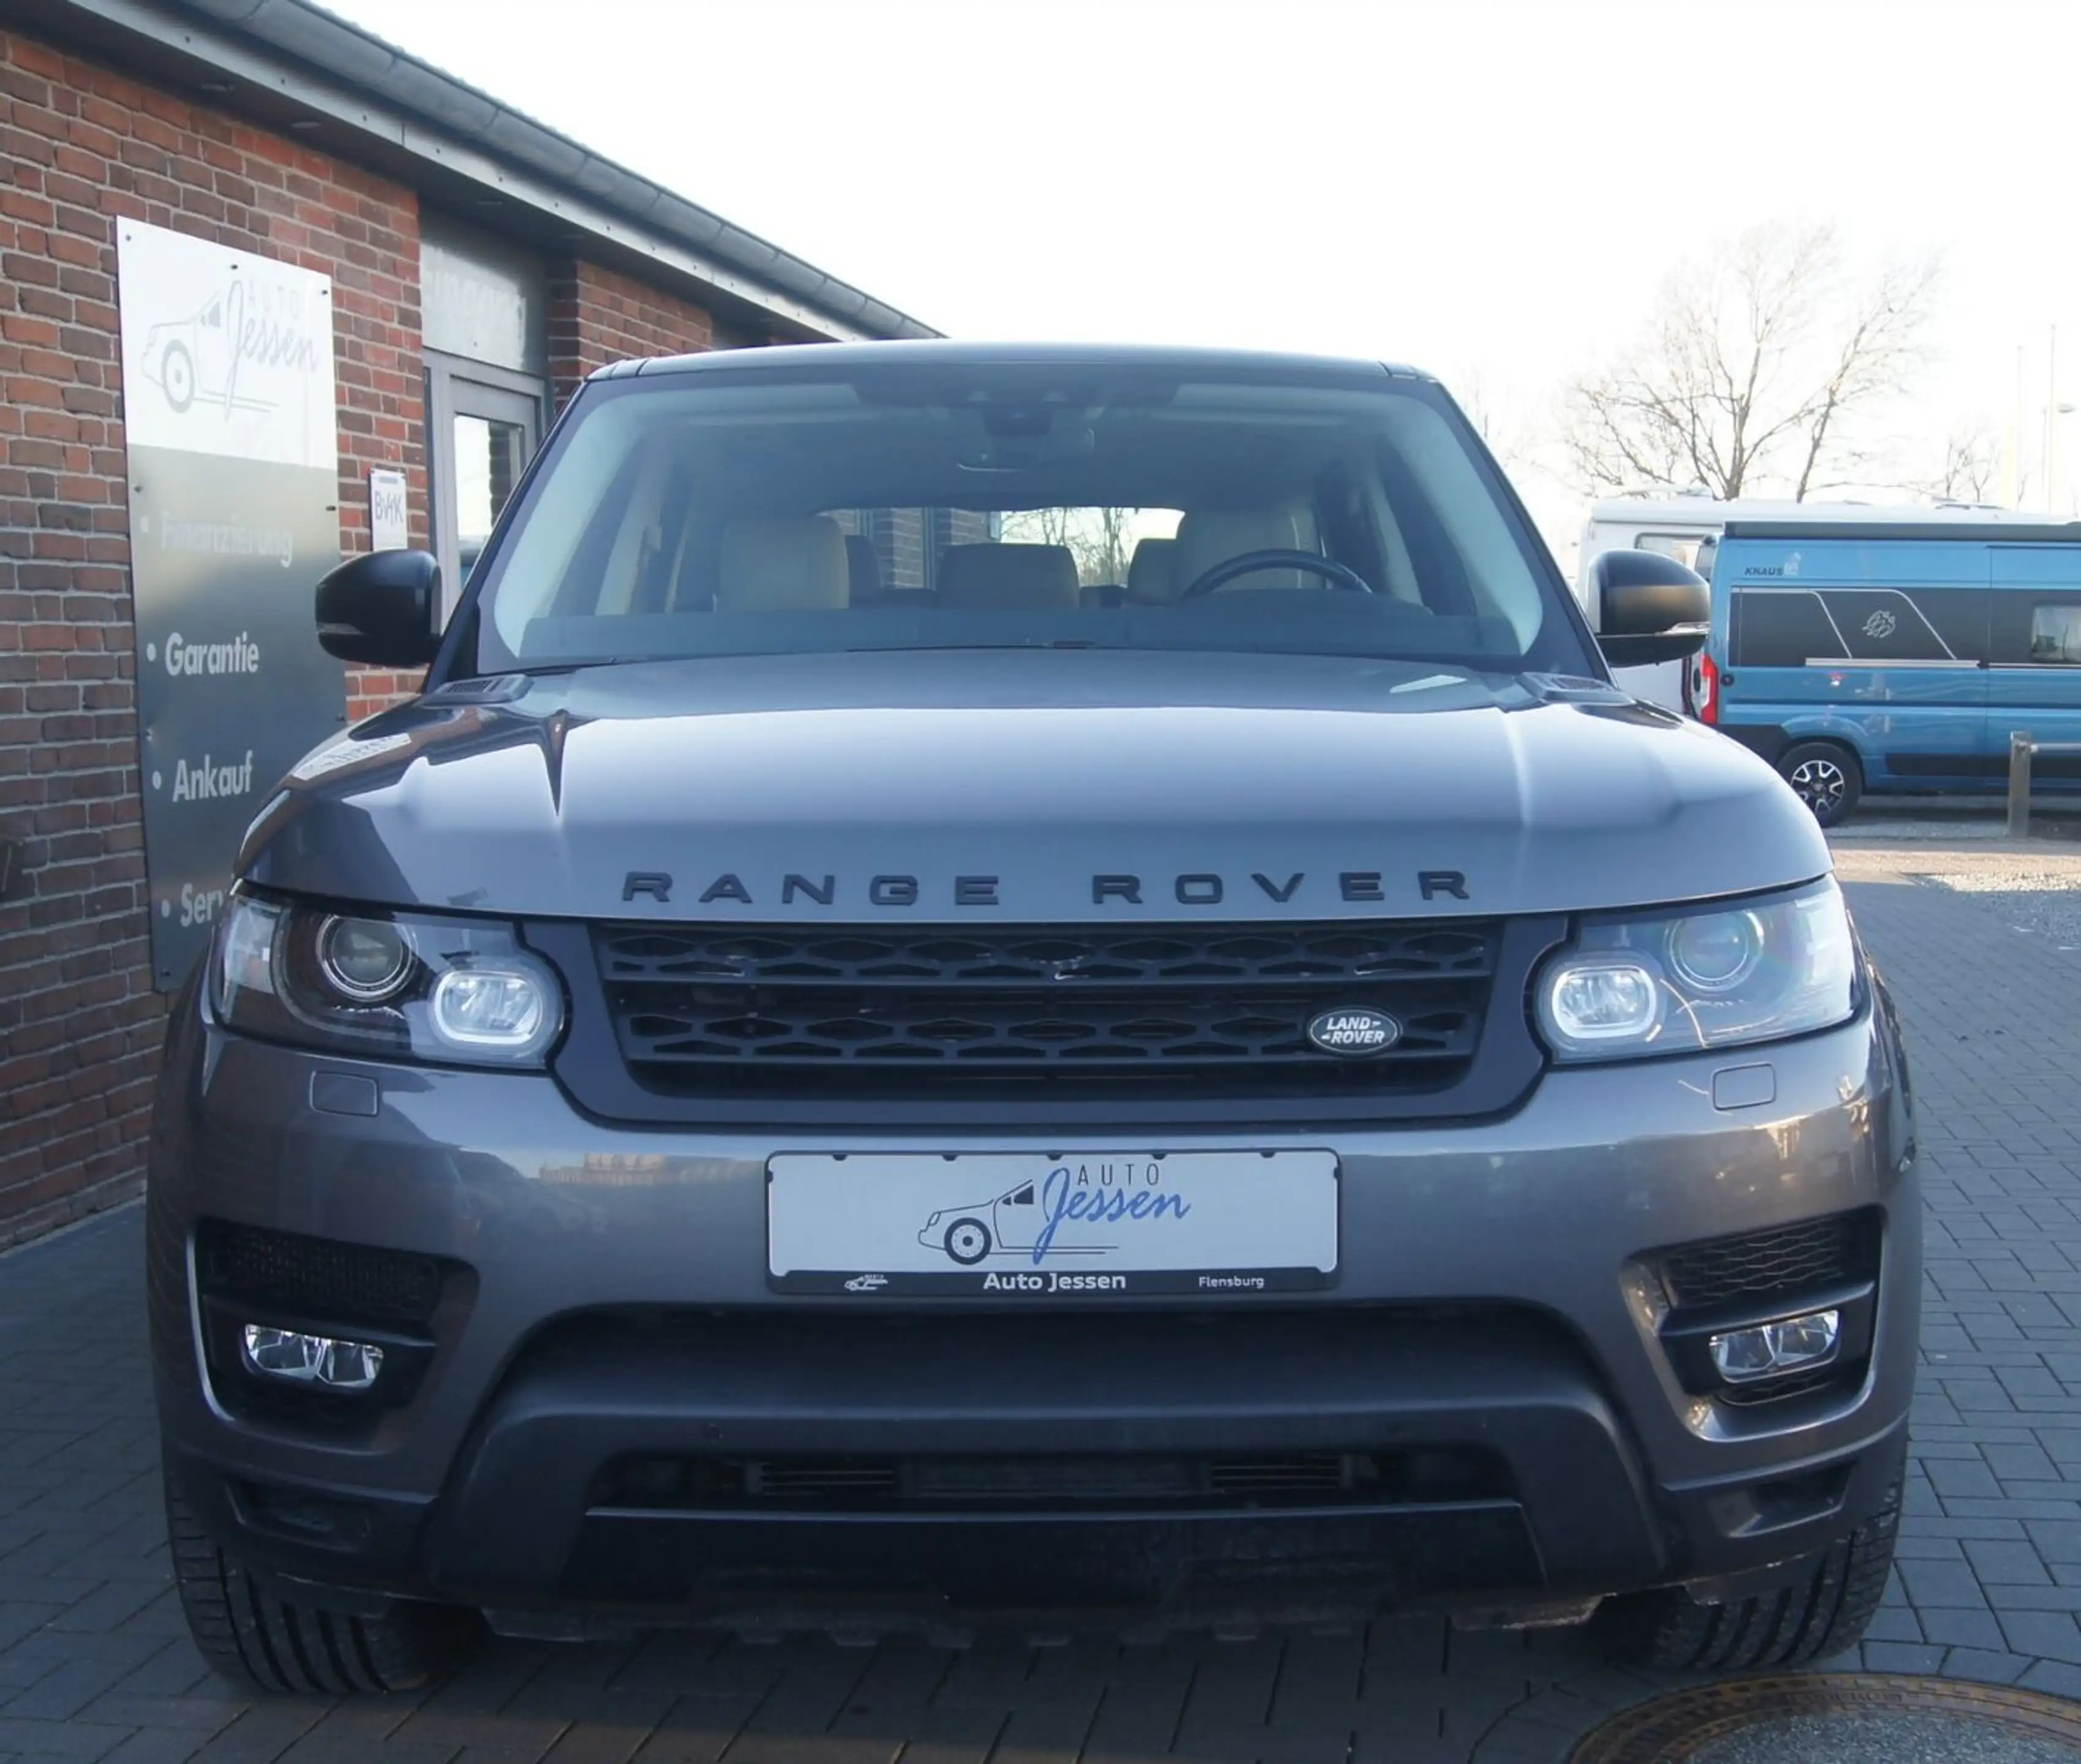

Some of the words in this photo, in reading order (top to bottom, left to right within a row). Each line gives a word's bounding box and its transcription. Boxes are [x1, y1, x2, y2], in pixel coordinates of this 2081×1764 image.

[247, 278, 300, 319] AUTO
[225, 279, 320, 422] Jessen
[165, 631, 260, 676] Garantie
[172, 749, 254, 802] Ankauf
[621, 871, 999, 906] RANGE
[1092, 870, 1470, 904] ROVER
[1077, 1163, 1159, 1186] AUTO
[1033, 1167, 1191, 1265] Jessen
[983, 1273, 1043, 1290] Auto
[1047, 1272, 1126, 1292] Jessen
[1199, 1275, 1265, 1289] Flensburg
